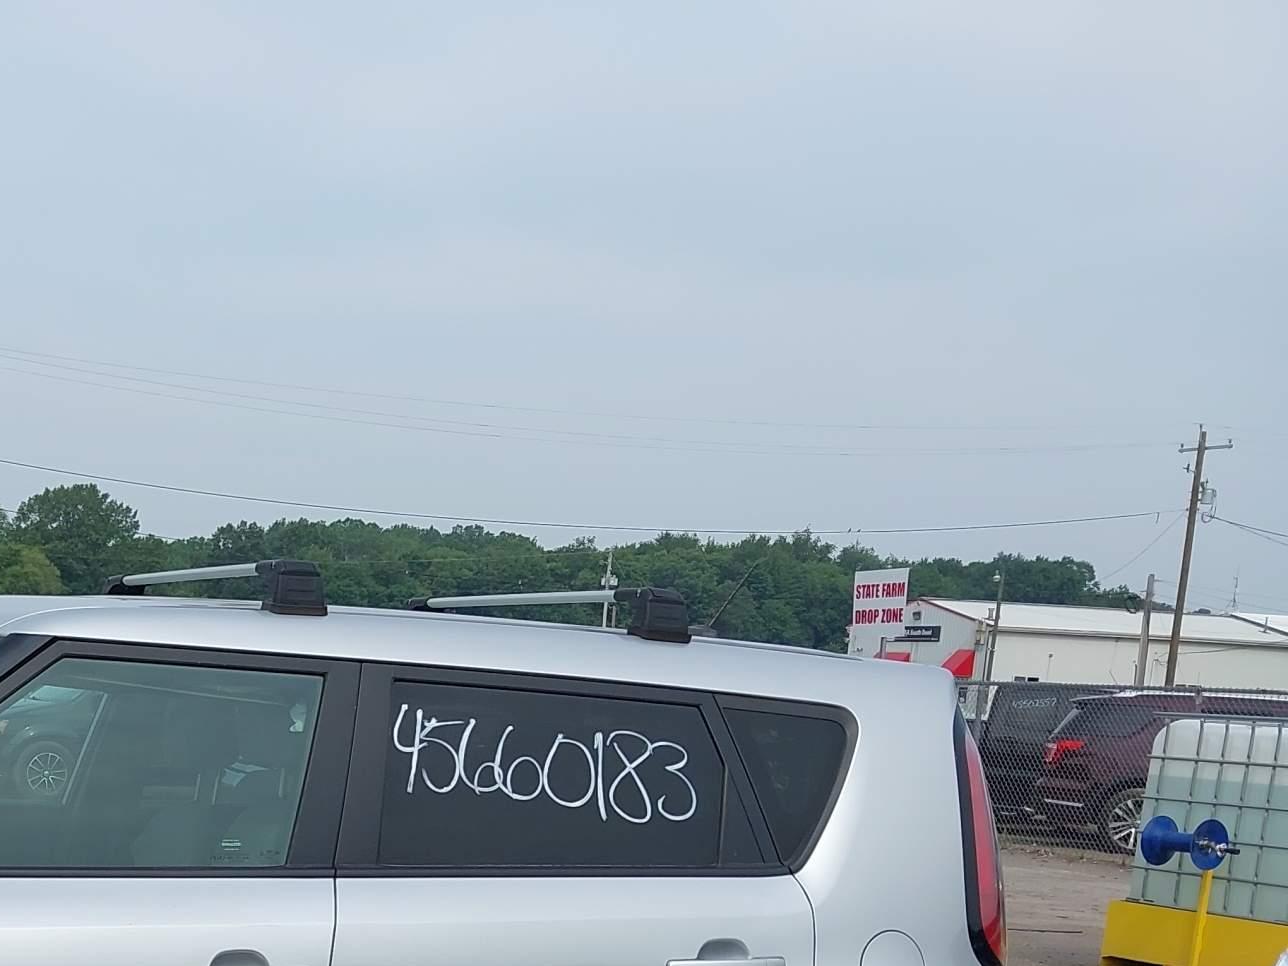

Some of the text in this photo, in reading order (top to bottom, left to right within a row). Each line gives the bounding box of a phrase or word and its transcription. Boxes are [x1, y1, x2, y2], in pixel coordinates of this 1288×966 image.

[855, 581, 906, 600] STATE FARM
[855, 607, 904, 625] DROP ZONE
[393, 703, 697, 824] 45660183
